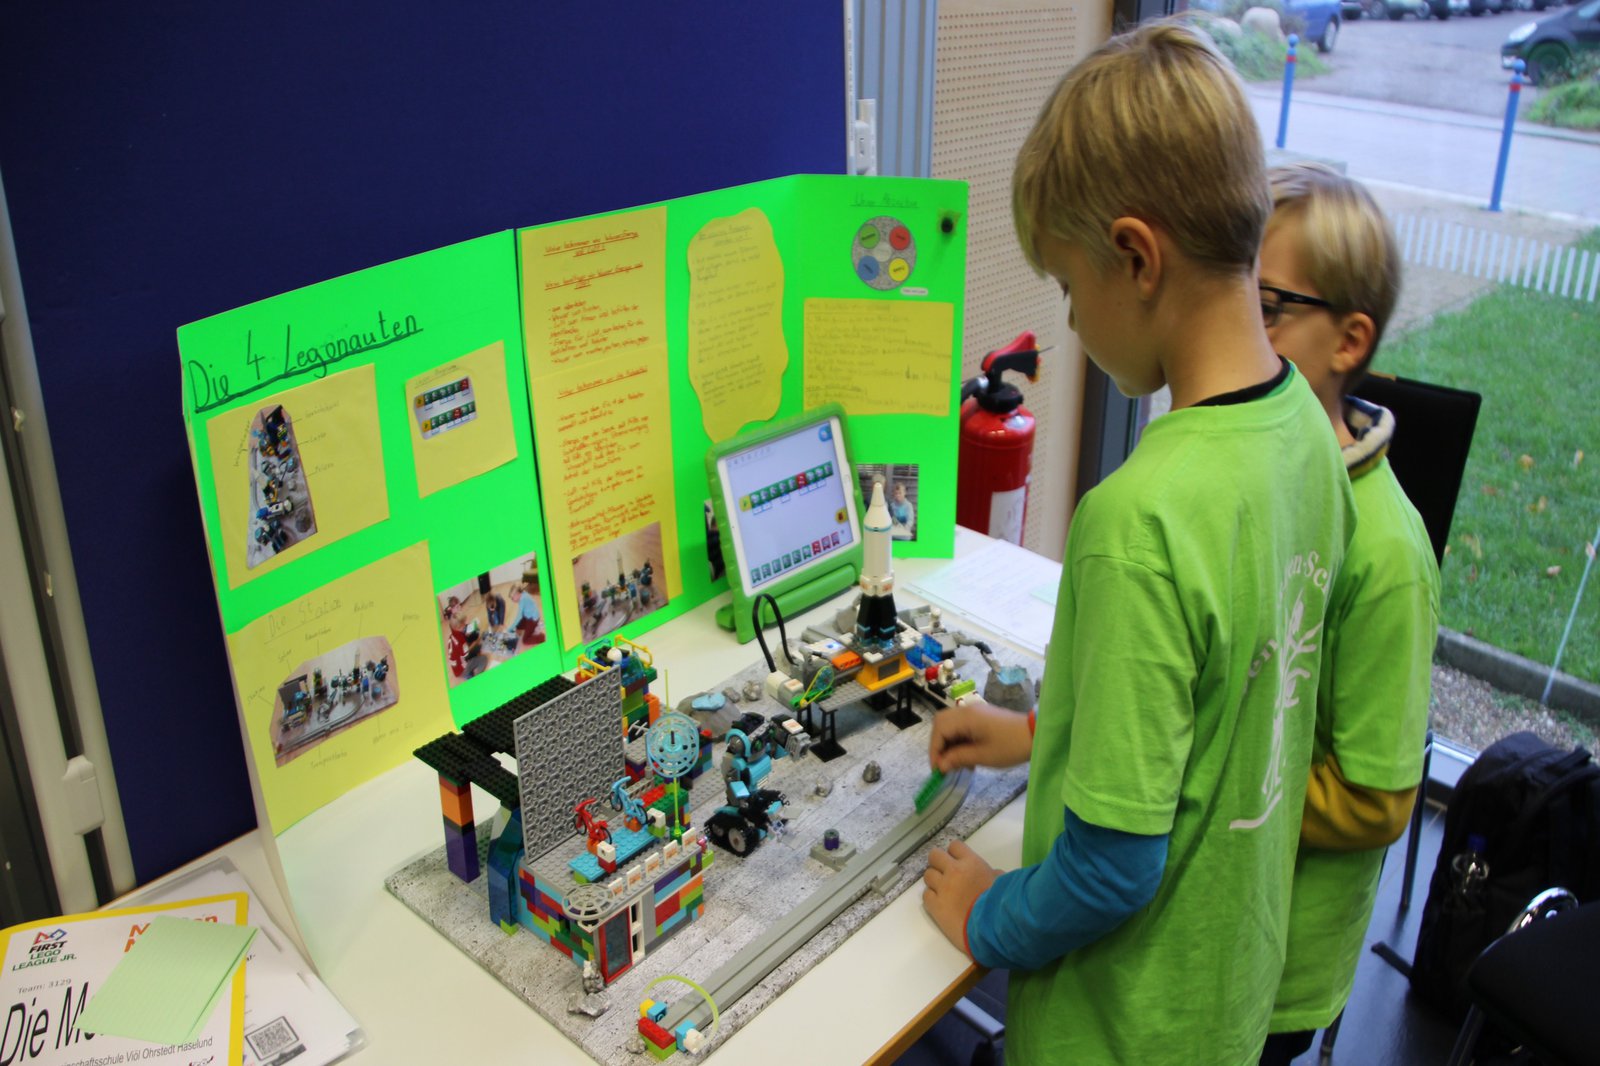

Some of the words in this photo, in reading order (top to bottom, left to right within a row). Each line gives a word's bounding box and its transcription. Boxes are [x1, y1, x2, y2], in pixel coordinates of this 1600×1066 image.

[187, 359, 230, 409] Die
[246, 329, 266, 381] 4
[283, 310, 419, 379] Legonauten
[28, 940, 69, 955] FIRST
[30, 949, 62, 961] LEGO
[12, 955, 57, 972] LEAGUE
[60, 953, 77, 962] JR.
[18, 983, 46, 994] Team:
[48, 978, 72, 989] 3129
[0, 997, 49, 1066] Die
